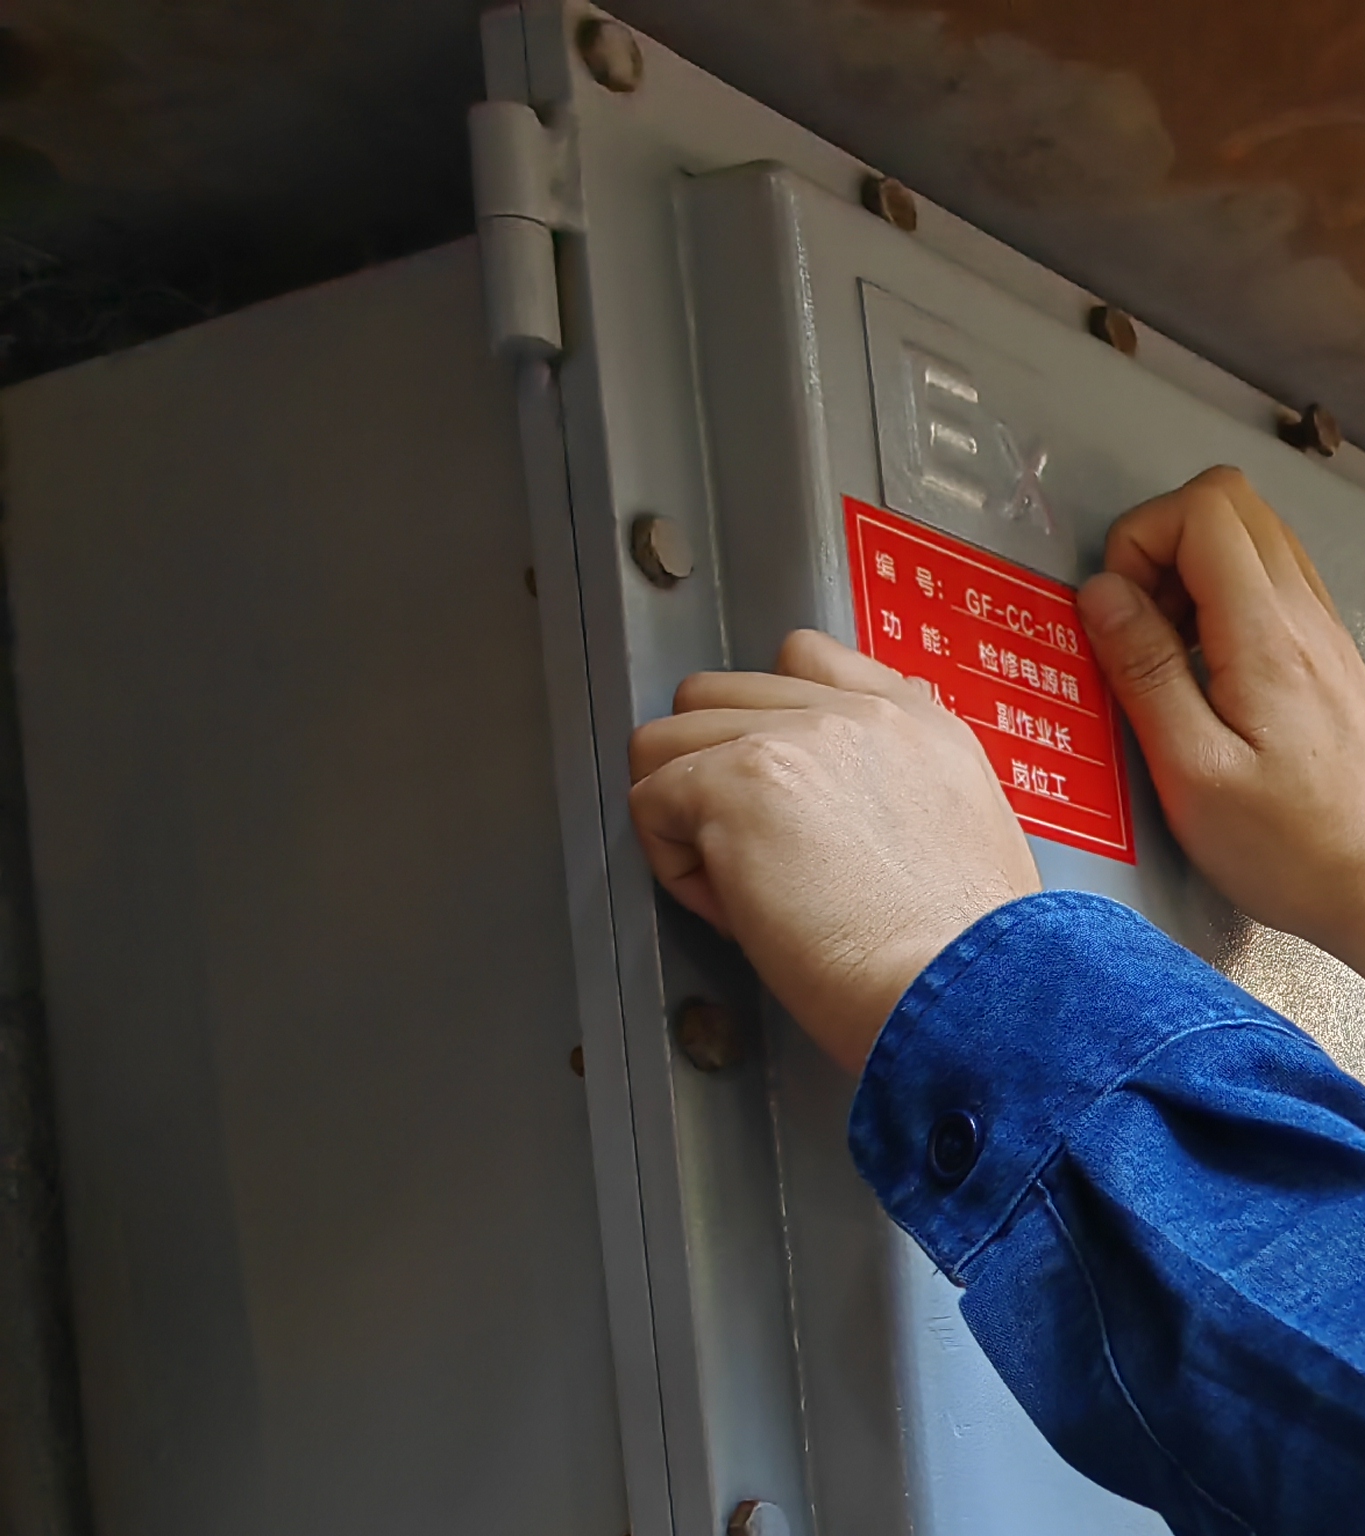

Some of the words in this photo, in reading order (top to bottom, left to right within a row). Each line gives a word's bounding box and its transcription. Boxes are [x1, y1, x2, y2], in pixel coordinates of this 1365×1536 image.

[965, 588, 1079, 655] GF-CC-163
[978, 639, 1081, 704] 检修电源箱
[995, 701, 1074, 752] 副作业长
[1011, 758, 1070, 801] 岗位工
